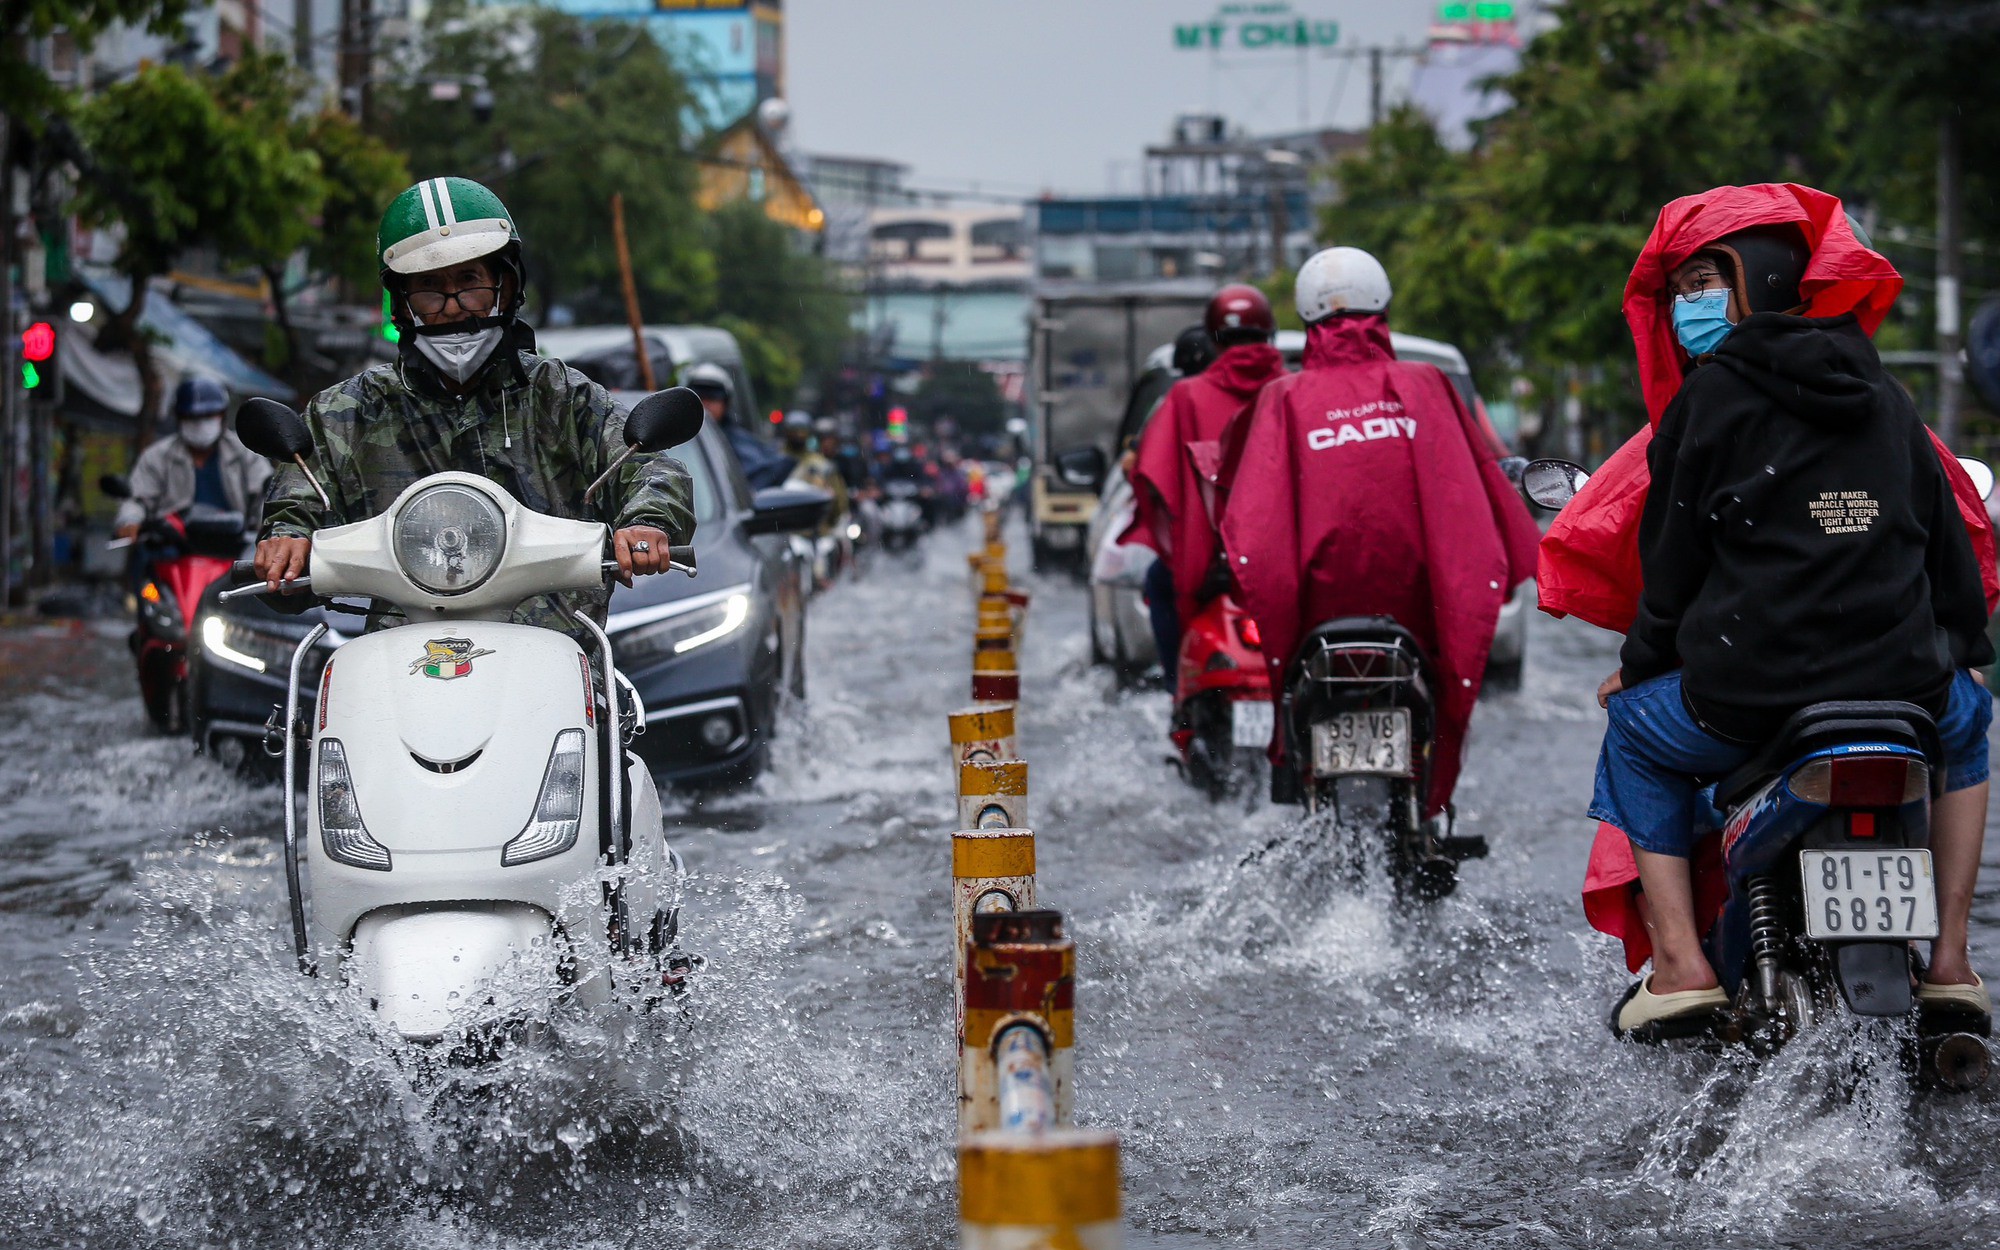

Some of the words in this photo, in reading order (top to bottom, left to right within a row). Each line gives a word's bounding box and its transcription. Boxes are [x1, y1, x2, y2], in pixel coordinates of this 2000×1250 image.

[1820, 492, 1838, 500] WAY
[1841, 491, 1868, 499] MAKER
[1809, 501, 1844, 509] MIRACLE
[1846, 500, 1879, 508] WORKER
[1811, 509, 1846, 518] PROMISE
[1849, 509, 1879, 517] KEEPER
[1819, 518, 1842, 526] LIGHT
[1845, 517, 1853, 525] IN
[1856, 517, 1872, 525] THE
[1825, 525, 1868, 534] DARKNESS
[1848, 745, 1891, 753] HONDA
[1821, 856, 1914, 891] 81-F9
[1824, 897, 1916, 932] 6837
